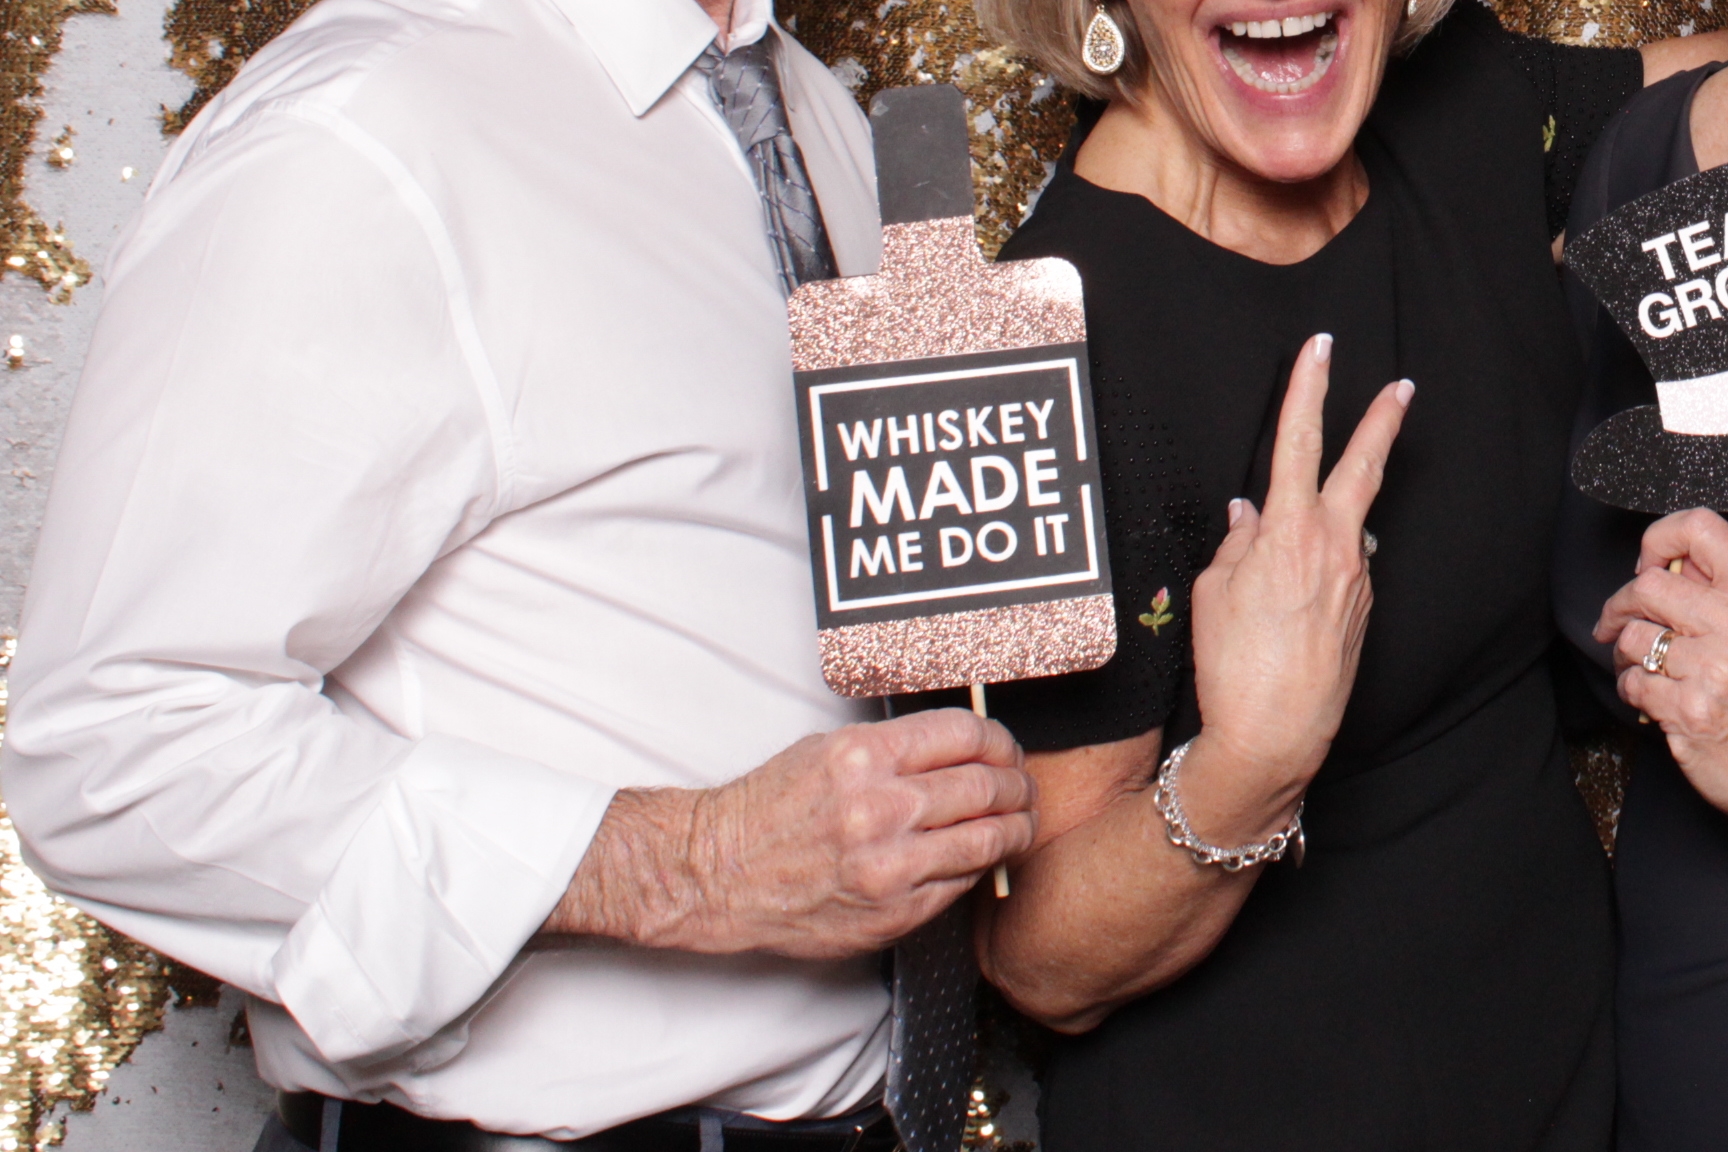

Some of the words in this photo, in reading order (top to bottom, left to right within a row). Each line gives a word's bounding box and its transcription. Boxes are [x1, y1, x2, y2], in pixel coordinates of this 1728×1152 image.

[836, 398, 1055, 462] WHISKEY
[849, 448, 1061, 529] MADE
[850, 531, 924, 579] ME
[938, 520, 1018, 568] DO
[1033, 513, 1069, 557] IT
